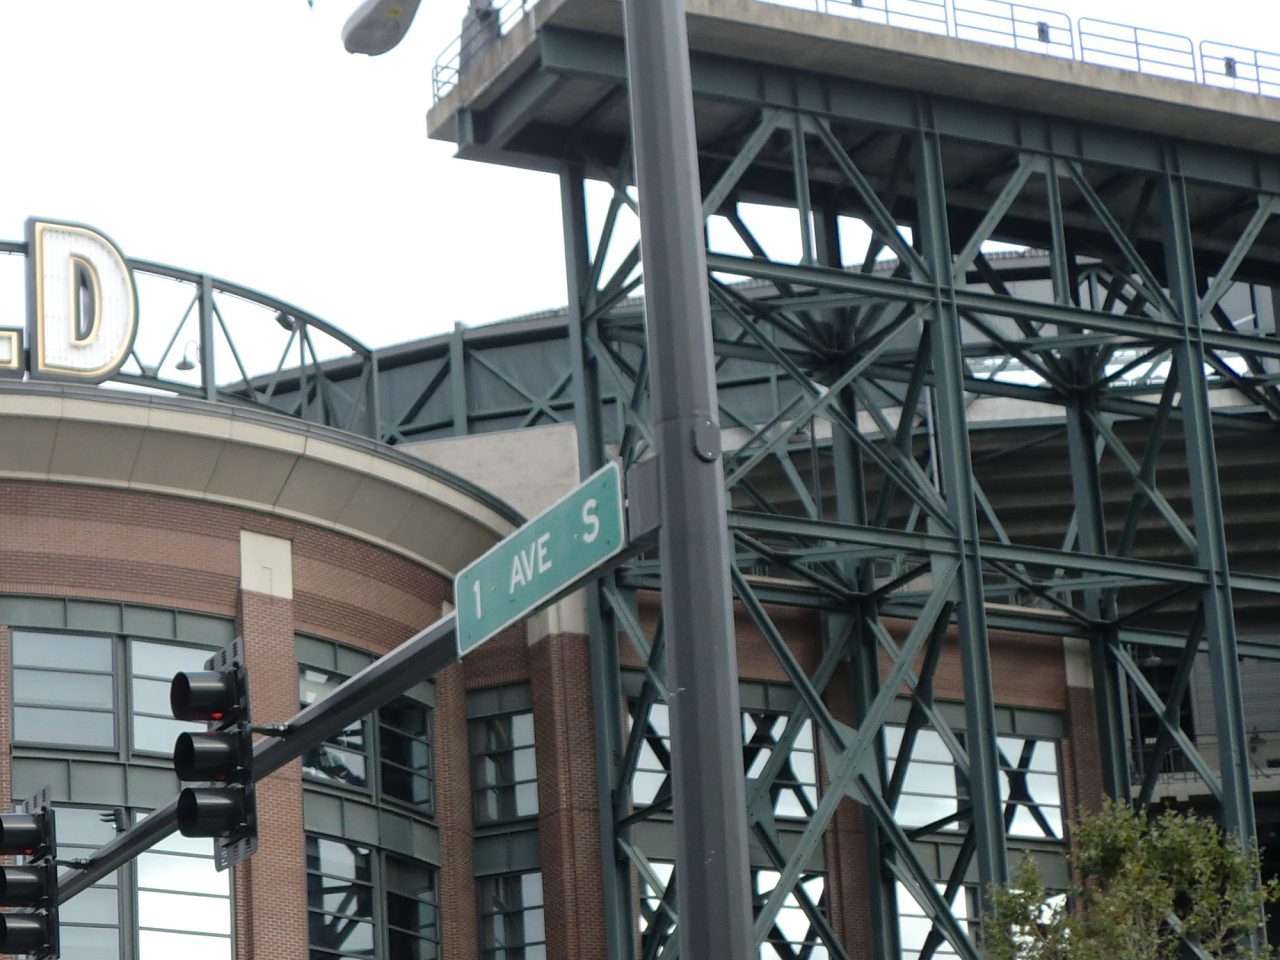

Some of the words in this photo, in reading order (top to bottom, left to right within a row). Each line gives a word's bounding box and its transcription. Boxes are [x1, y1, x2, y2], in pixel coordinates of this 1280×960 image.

[473, 579, 482, 619] 1
[510, 532, 553, 594] AVE
[582, 499, 600, 543] S
